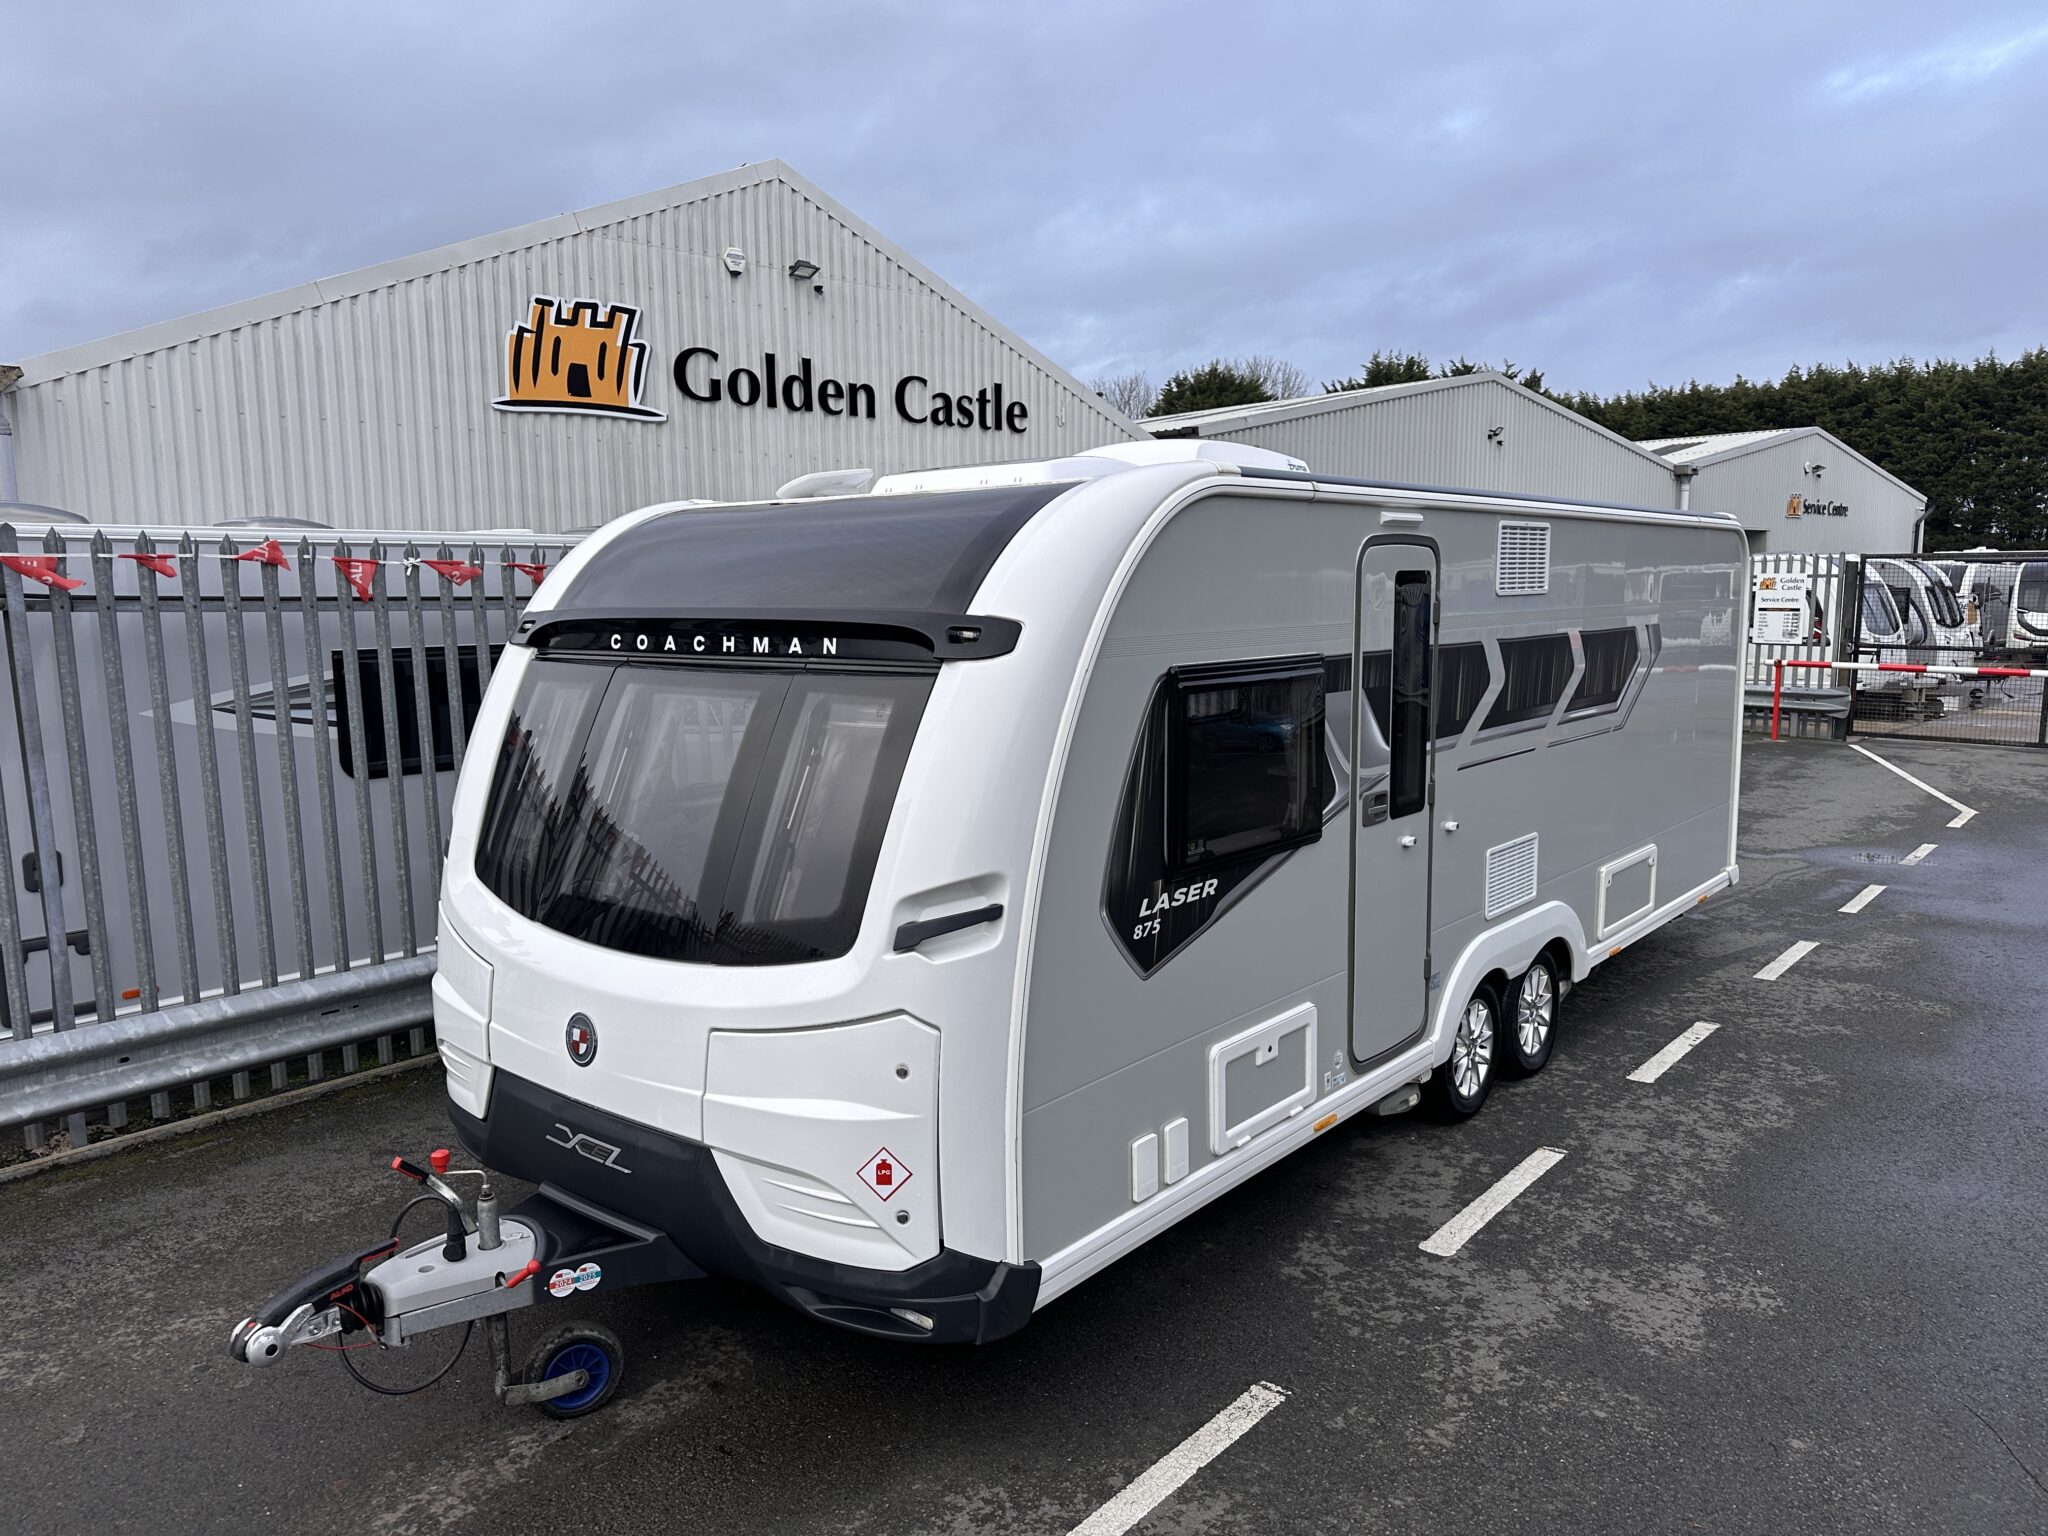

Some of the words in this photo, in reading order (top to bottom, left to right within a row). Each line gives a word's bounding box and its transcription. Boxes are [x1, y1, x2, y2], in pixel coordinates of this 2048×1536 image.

[673, 347, 876, 419] Golden
[895, 375, 1029, 435] Castle
[1803, 498, 1827, 515] Service
[1828, 500, 1849, 517] Centre
[610, 634, 838, 655] COACHMAN
[1138, 878, 1219, 918] LASER
[1133, 918, 1162, 940] 875
[555, 1279, 573, 1288] 2024
[579, 1273, 597, 1282] 2025
